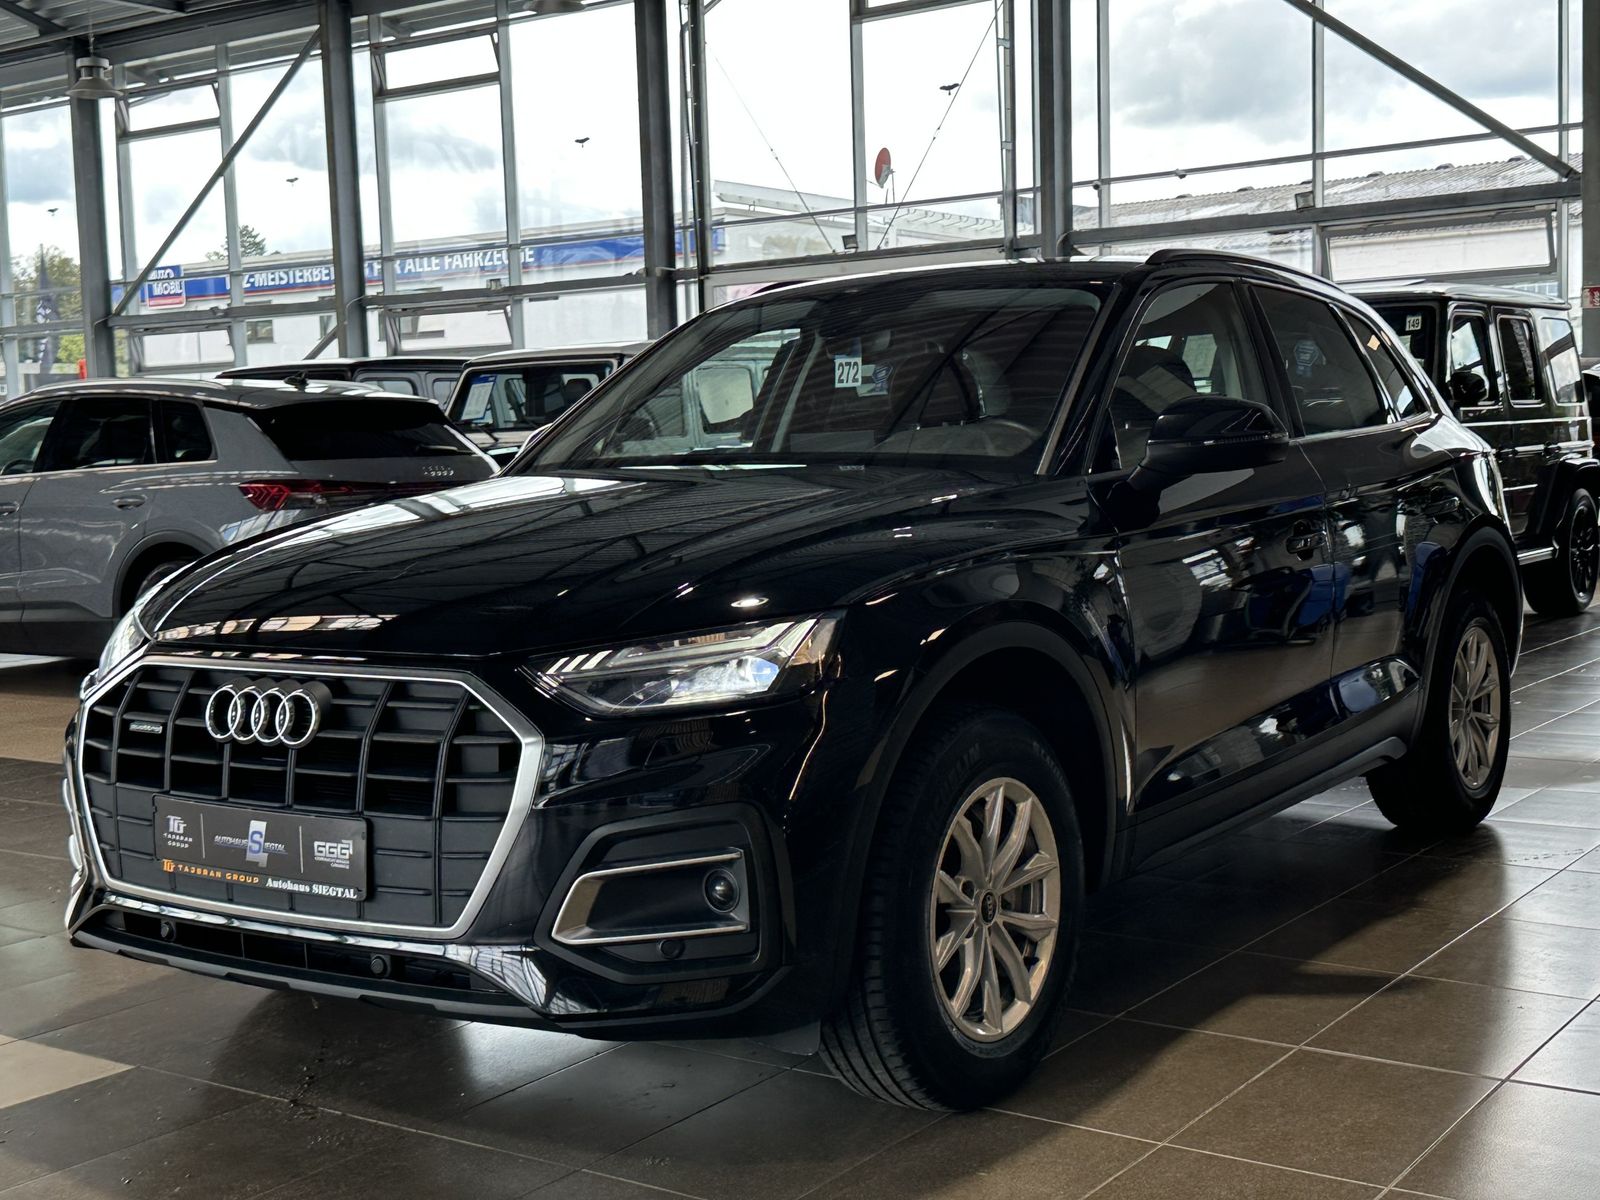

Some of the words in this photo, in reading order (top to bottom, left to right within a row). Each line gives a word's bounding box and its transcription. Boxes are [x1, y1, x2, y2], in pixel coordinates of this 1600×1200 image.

[403, 256, 441, 274] ALLE
[1407, 318, 1420, 329] 149
[837, 361, 860, 383] 272
[314, 840, 350, 859] GGG
[225, 872, 259, 884] GROUP
[265, 877, 310, 893] Autohaus
[311, 883, 358, 899] SIEGTAL
